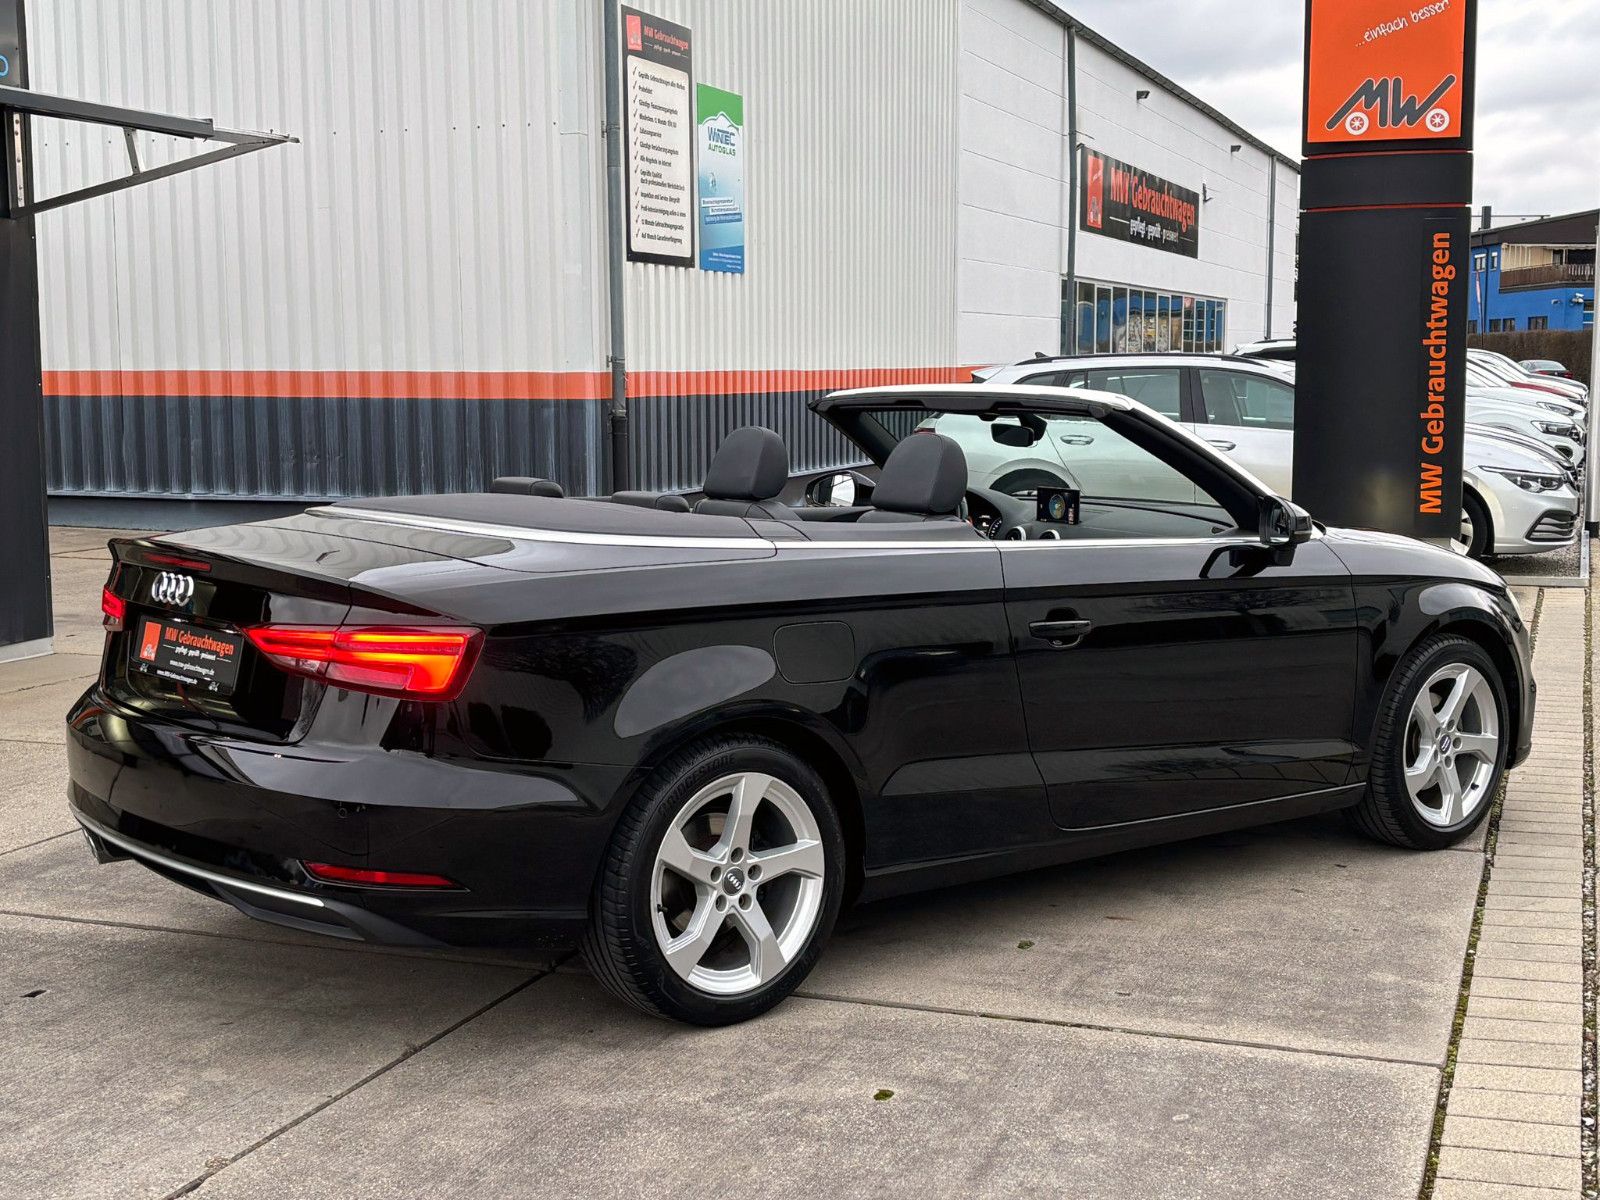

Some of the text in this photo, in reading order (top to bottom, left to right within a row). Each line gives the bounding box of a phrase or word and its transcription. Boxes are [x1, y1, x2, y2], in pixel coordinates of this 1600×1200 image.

[1326, 74, 1456, 130] MW
[708, 142, 736, 157] AUTOGLAS
[1110, 167, 1130, 204] MW
[1131, 175, 1195, 233] Gebrauchtwagen
[1420, 232, 1456, 514] MW Gebrauchtwagen
[164, 626, 179, 642] MW
[179, 630, 234, 657] Gebrauchtwagen
